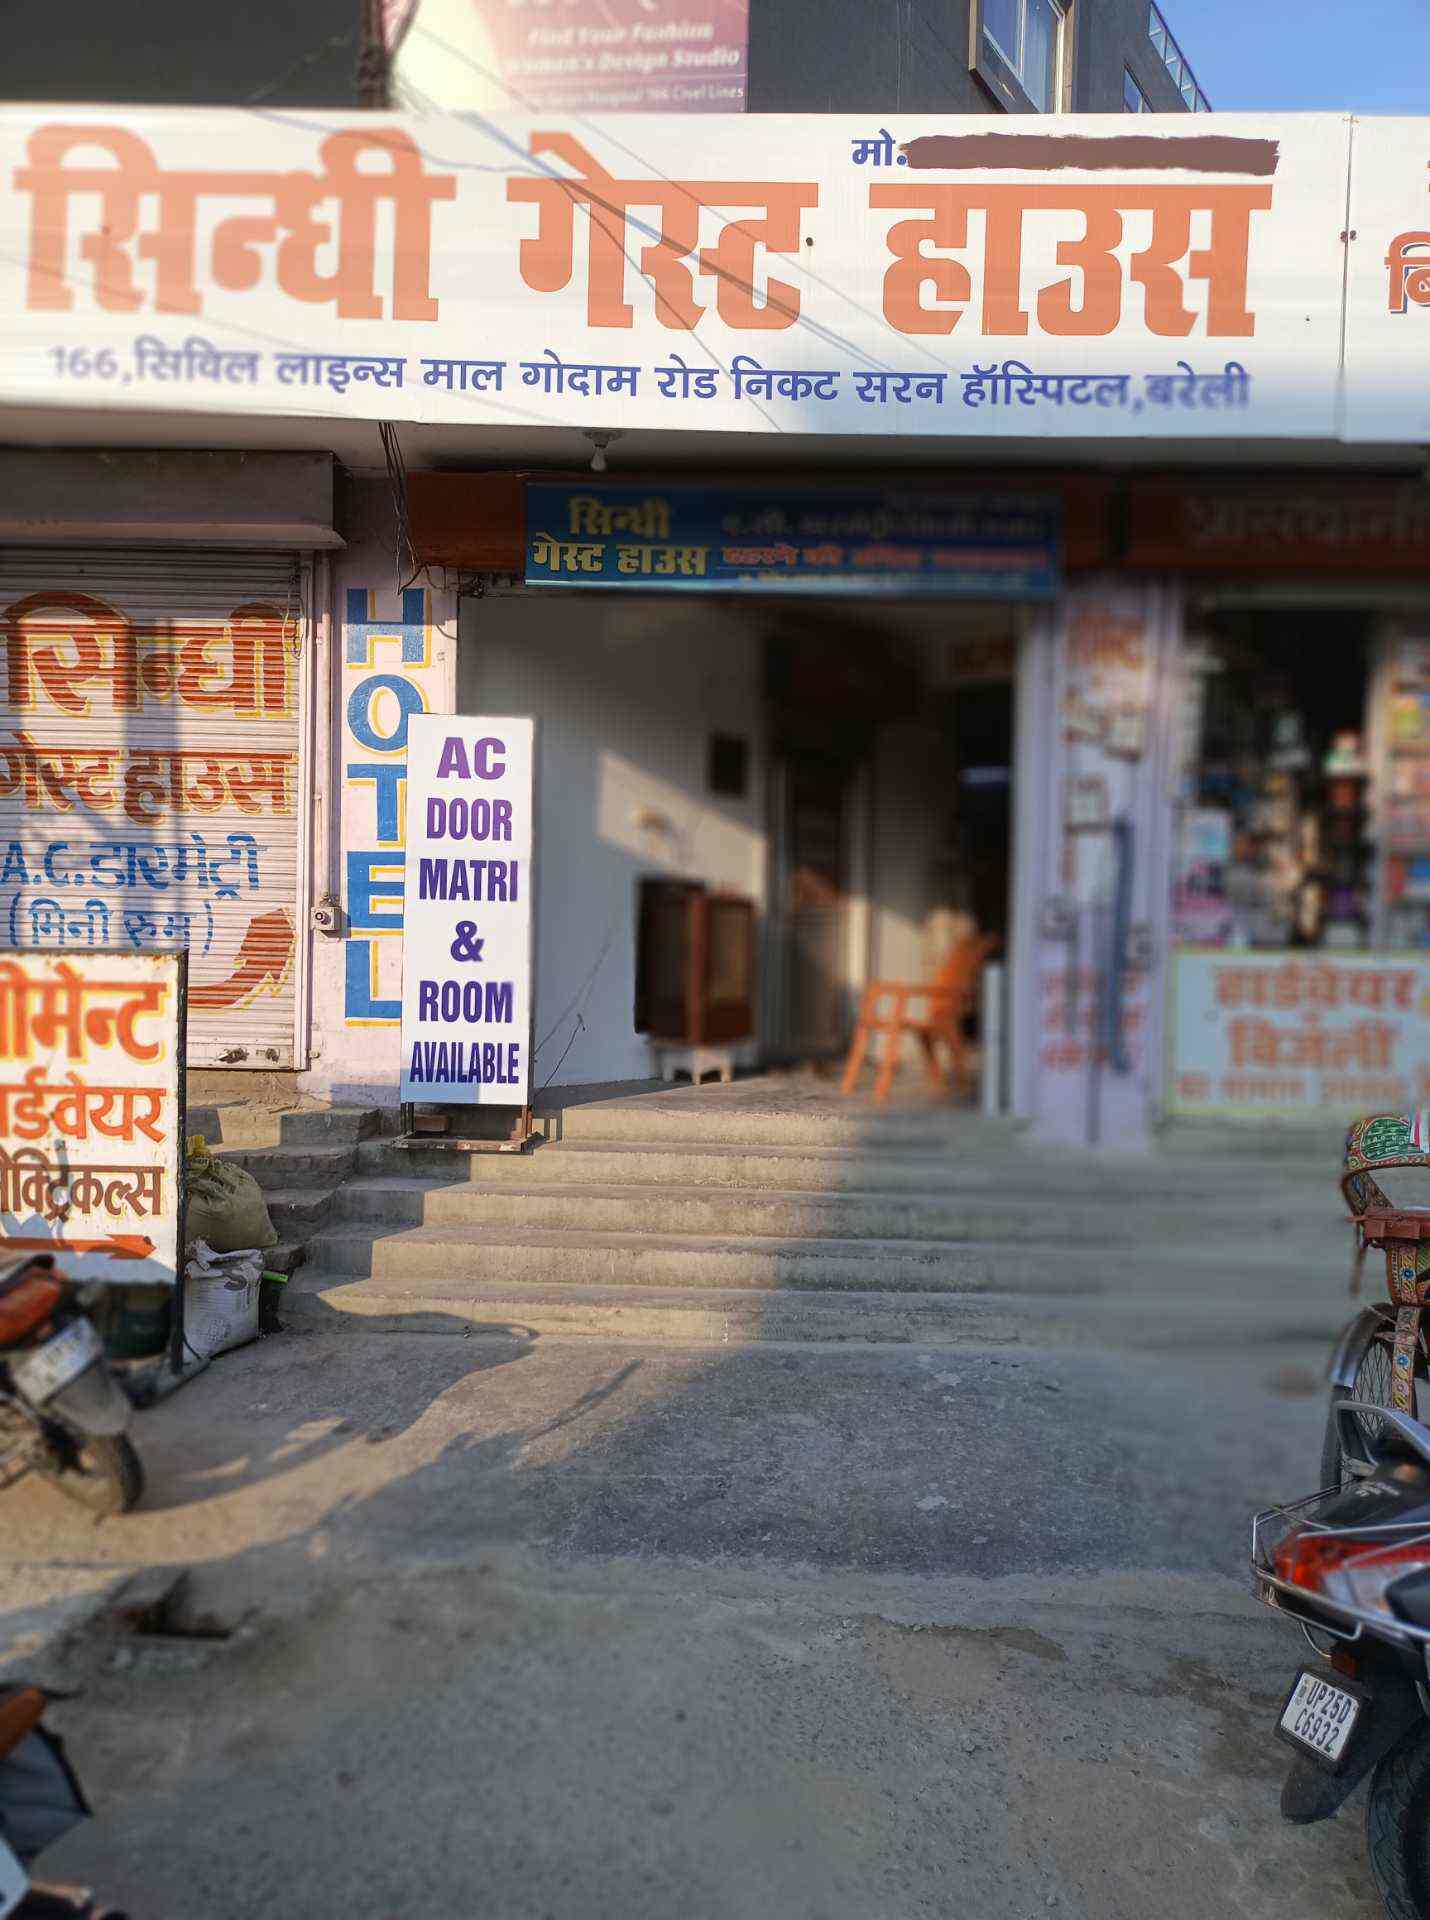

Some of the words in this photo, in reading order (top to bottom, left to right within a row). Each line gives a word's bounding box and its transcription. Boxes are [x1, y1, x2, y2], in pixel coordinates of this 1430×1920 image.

[13, 124, 456, 321] सिन्धी
[506, 131, 818, 329] गेस्ट
[869, 183, 1273, 337] हाउस
[274, 353, 407, 393] लाइन्स
[421, 359, 506, 391] माल
[520, 349, 641, 397] गोदाम
[654, 353, 719, 399] रोड
[730, 355, 840, 401] निकट
[852, 371, 948, 404] सरन
[532, 531, 605, 571] गेस्ट
[616, 544, 709, 575] हाउस
[437, 737, 506, 779] AC
[426, 797, 513, 841] DOOR
[419, 858, 519, 902] MATRI
[450, 920, 485, 962] &
[418, 980, 513, 1023] ROOM
[409, 1041, 521, 1084] AVAILABLE
